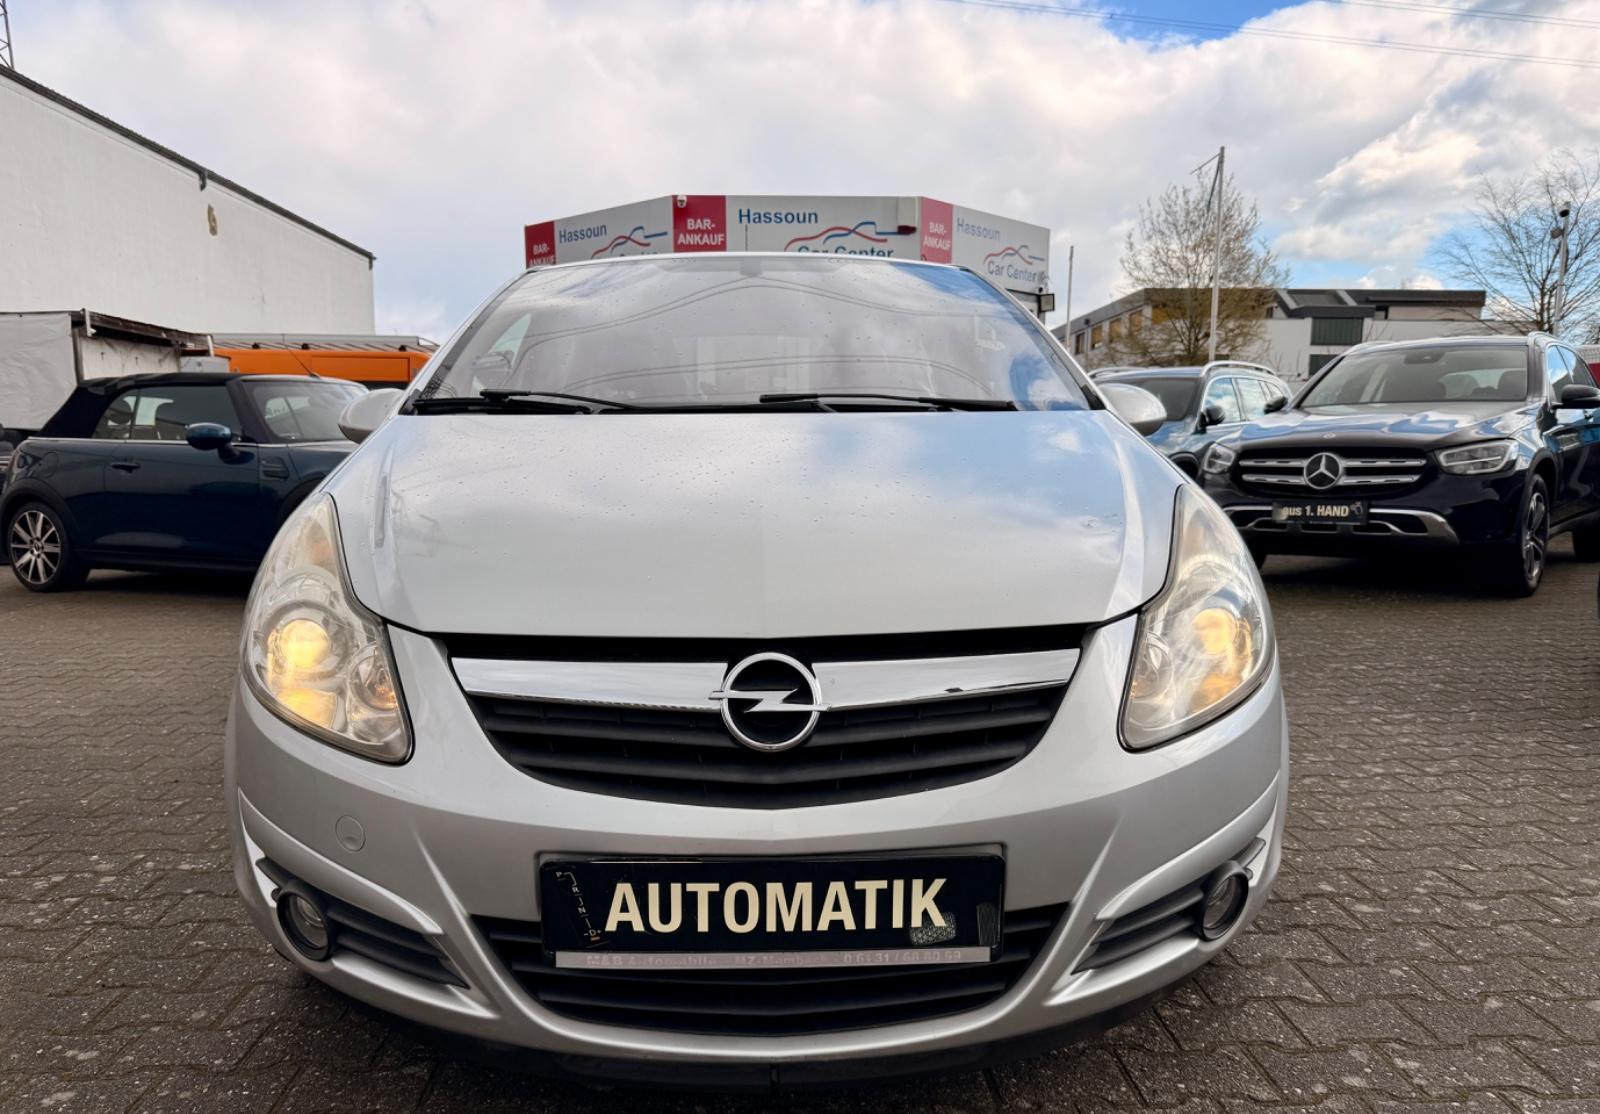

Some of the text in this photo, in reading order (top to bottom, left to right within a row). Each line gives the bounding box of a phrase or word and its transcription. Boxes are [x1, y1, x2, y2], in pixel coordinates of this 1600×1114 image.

[738, 208, 819, 225] Hassoun
[687, 218, 716, 230] BAR-
[929, 222, 947, 235] BAR-
[956, 217, 1000, 241] Hassoun
[559, 224, 608, 244] Hassoun
[678, 233, 725, 246] ANKAUF
[532, 243, 550, 255] BAR-
[922, 236, 952, 250] ANKAUF
[987, 261, 1038, 283] Car Center
[1317, 504, 1349, 517] HAND
[604, 877, 947, 934] AUTOMATIK
